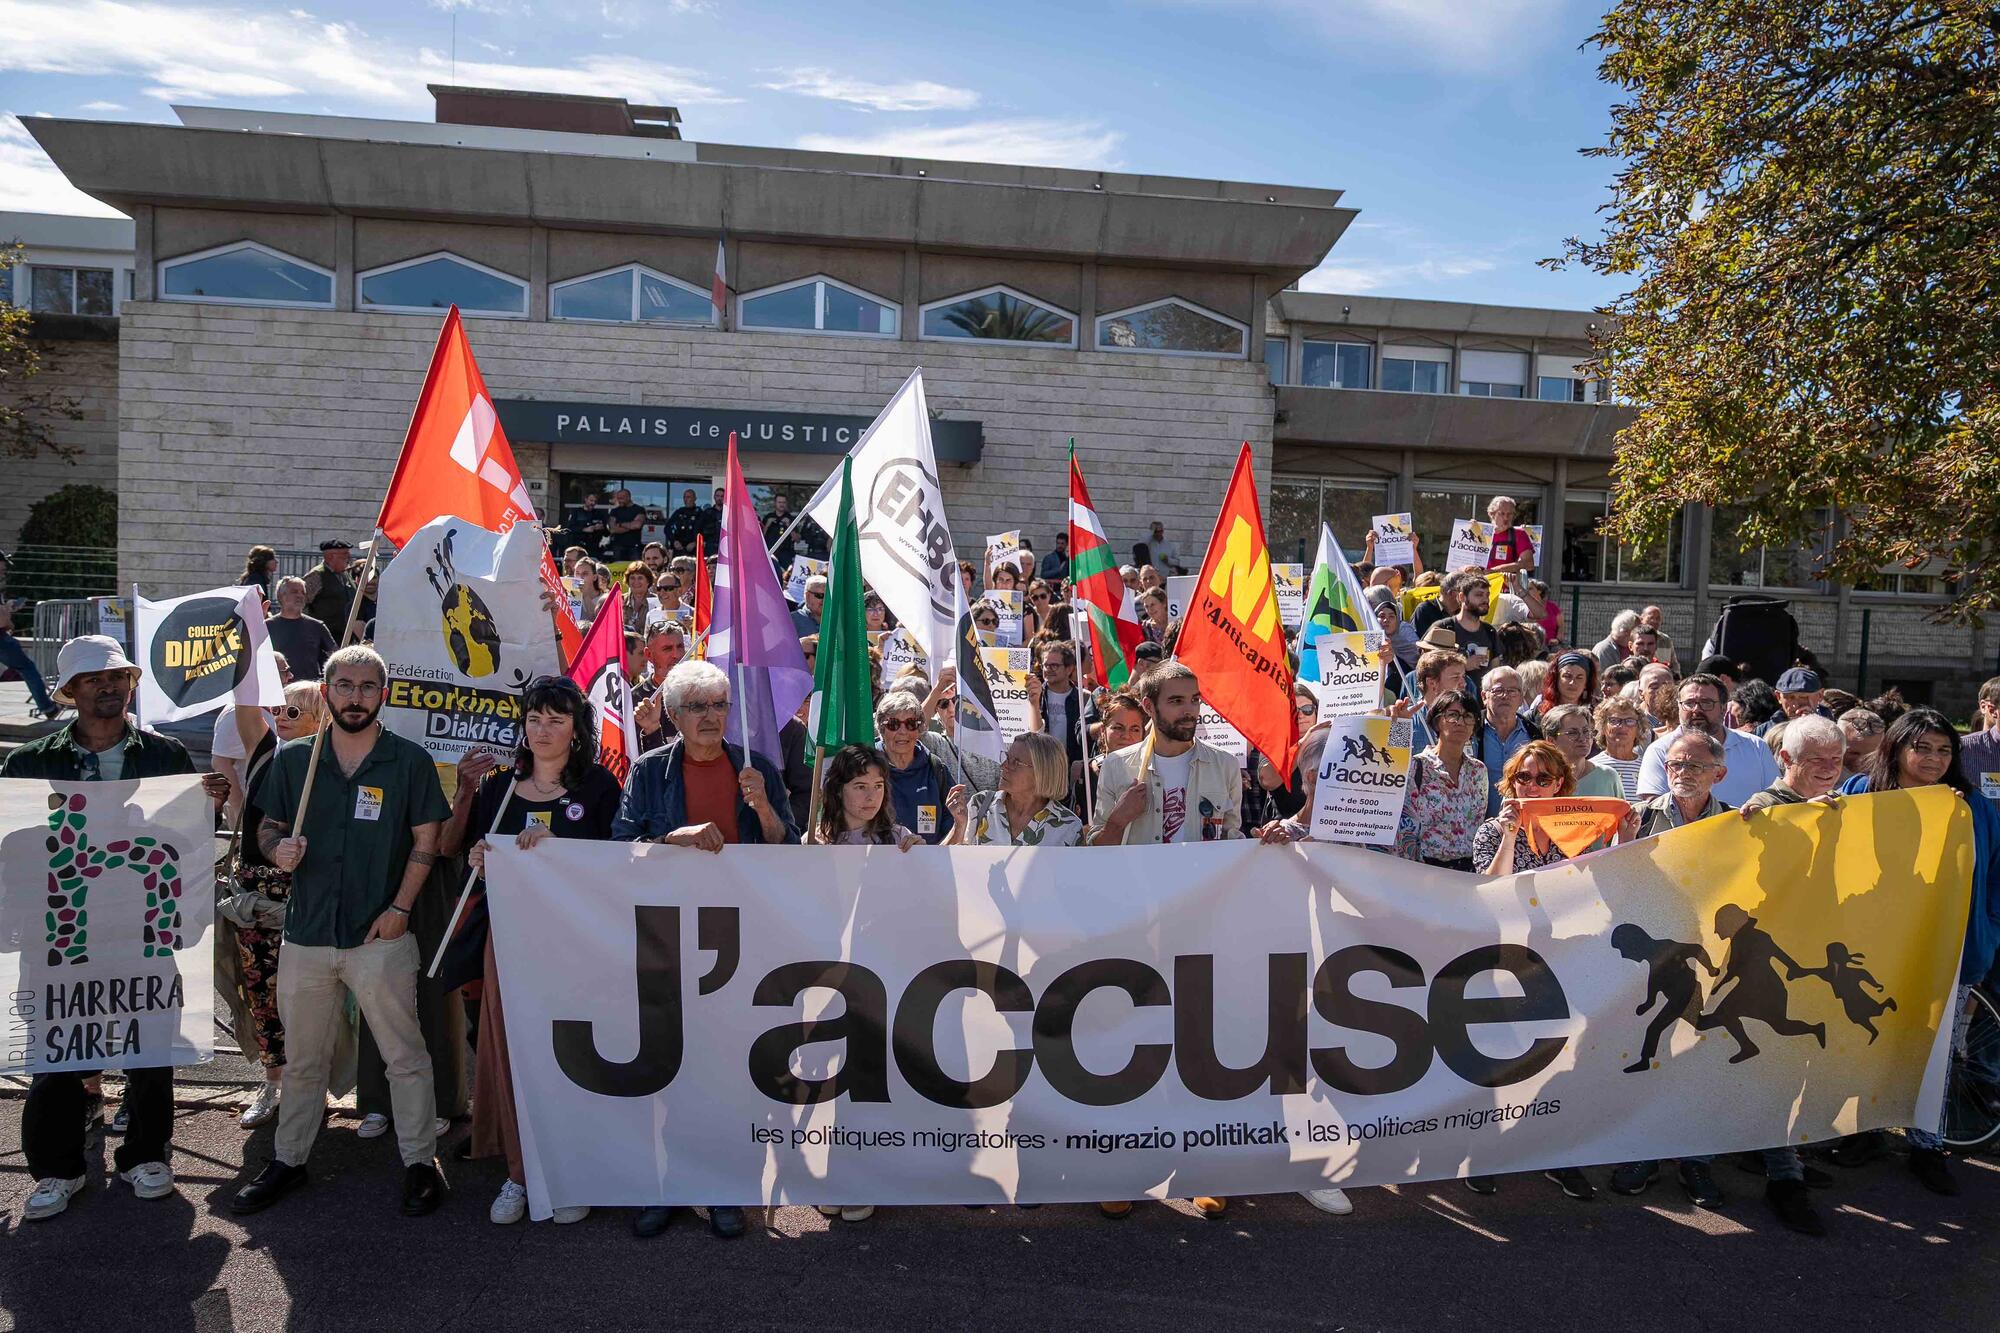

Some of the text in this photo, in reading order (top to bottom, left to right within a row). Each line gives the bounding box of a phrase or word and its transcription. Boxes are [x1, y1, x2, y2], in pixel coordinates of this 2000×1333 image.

[557, 415, 668, 435] PALAIS
[689, 421, 720, 437] de
[1451, 540, 1489, 553] J'accuse
[388, 663, 454, 681] Fédération
[1322, 671, 1379, 686] J'accuse
[992, 689, 1028, 699] cuse
[430, 712, 515, 744] Diakité
[1319, 762, 1406, 787] J'accuse
[1323, 804, 1393, 817] auto-inculpations
[1359, 798, 1379, 806] 5000
[1334, 828, 1376, 837] baino gehio
[1339, 820, 1394, 830] auto-inkulpazio
[46, 974, 184, 1020] HARRERA
[552, 904, 1571, 1109] J'accuse
[46, 1018, 141, 1064] SAREA
[751, 1098, 1561, 1153] les politiques migratoires migrazio politikak las políticas migratorias
